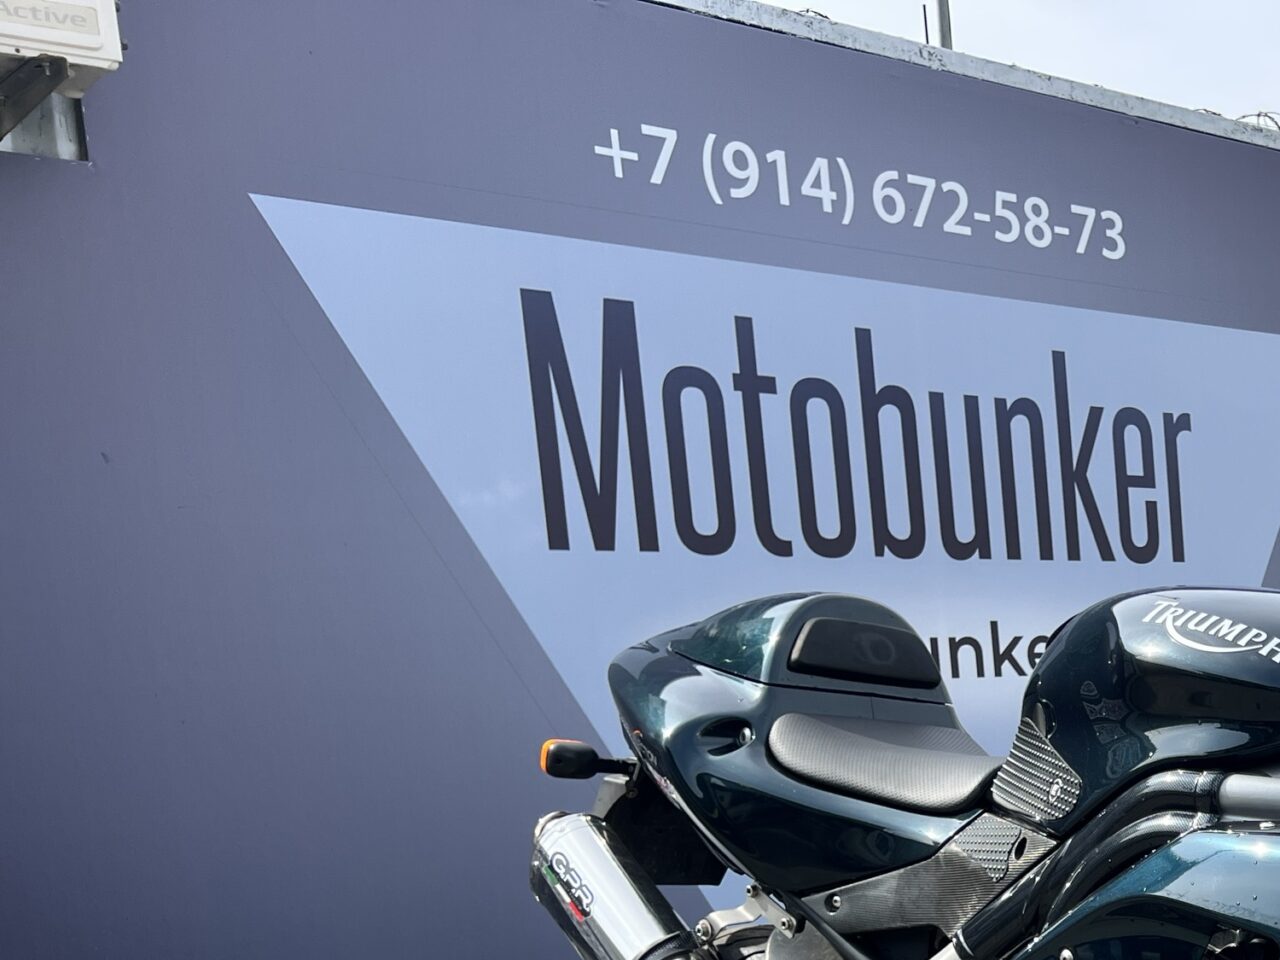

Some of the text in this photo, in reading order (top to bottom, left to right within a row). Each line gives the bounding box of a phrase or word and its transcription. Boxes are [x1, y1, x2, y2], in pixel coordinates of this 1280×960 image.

[594, 123, 1126, 260] +7 (914) 672-58-73
[519, 287, 1192, 565] Motobunker
